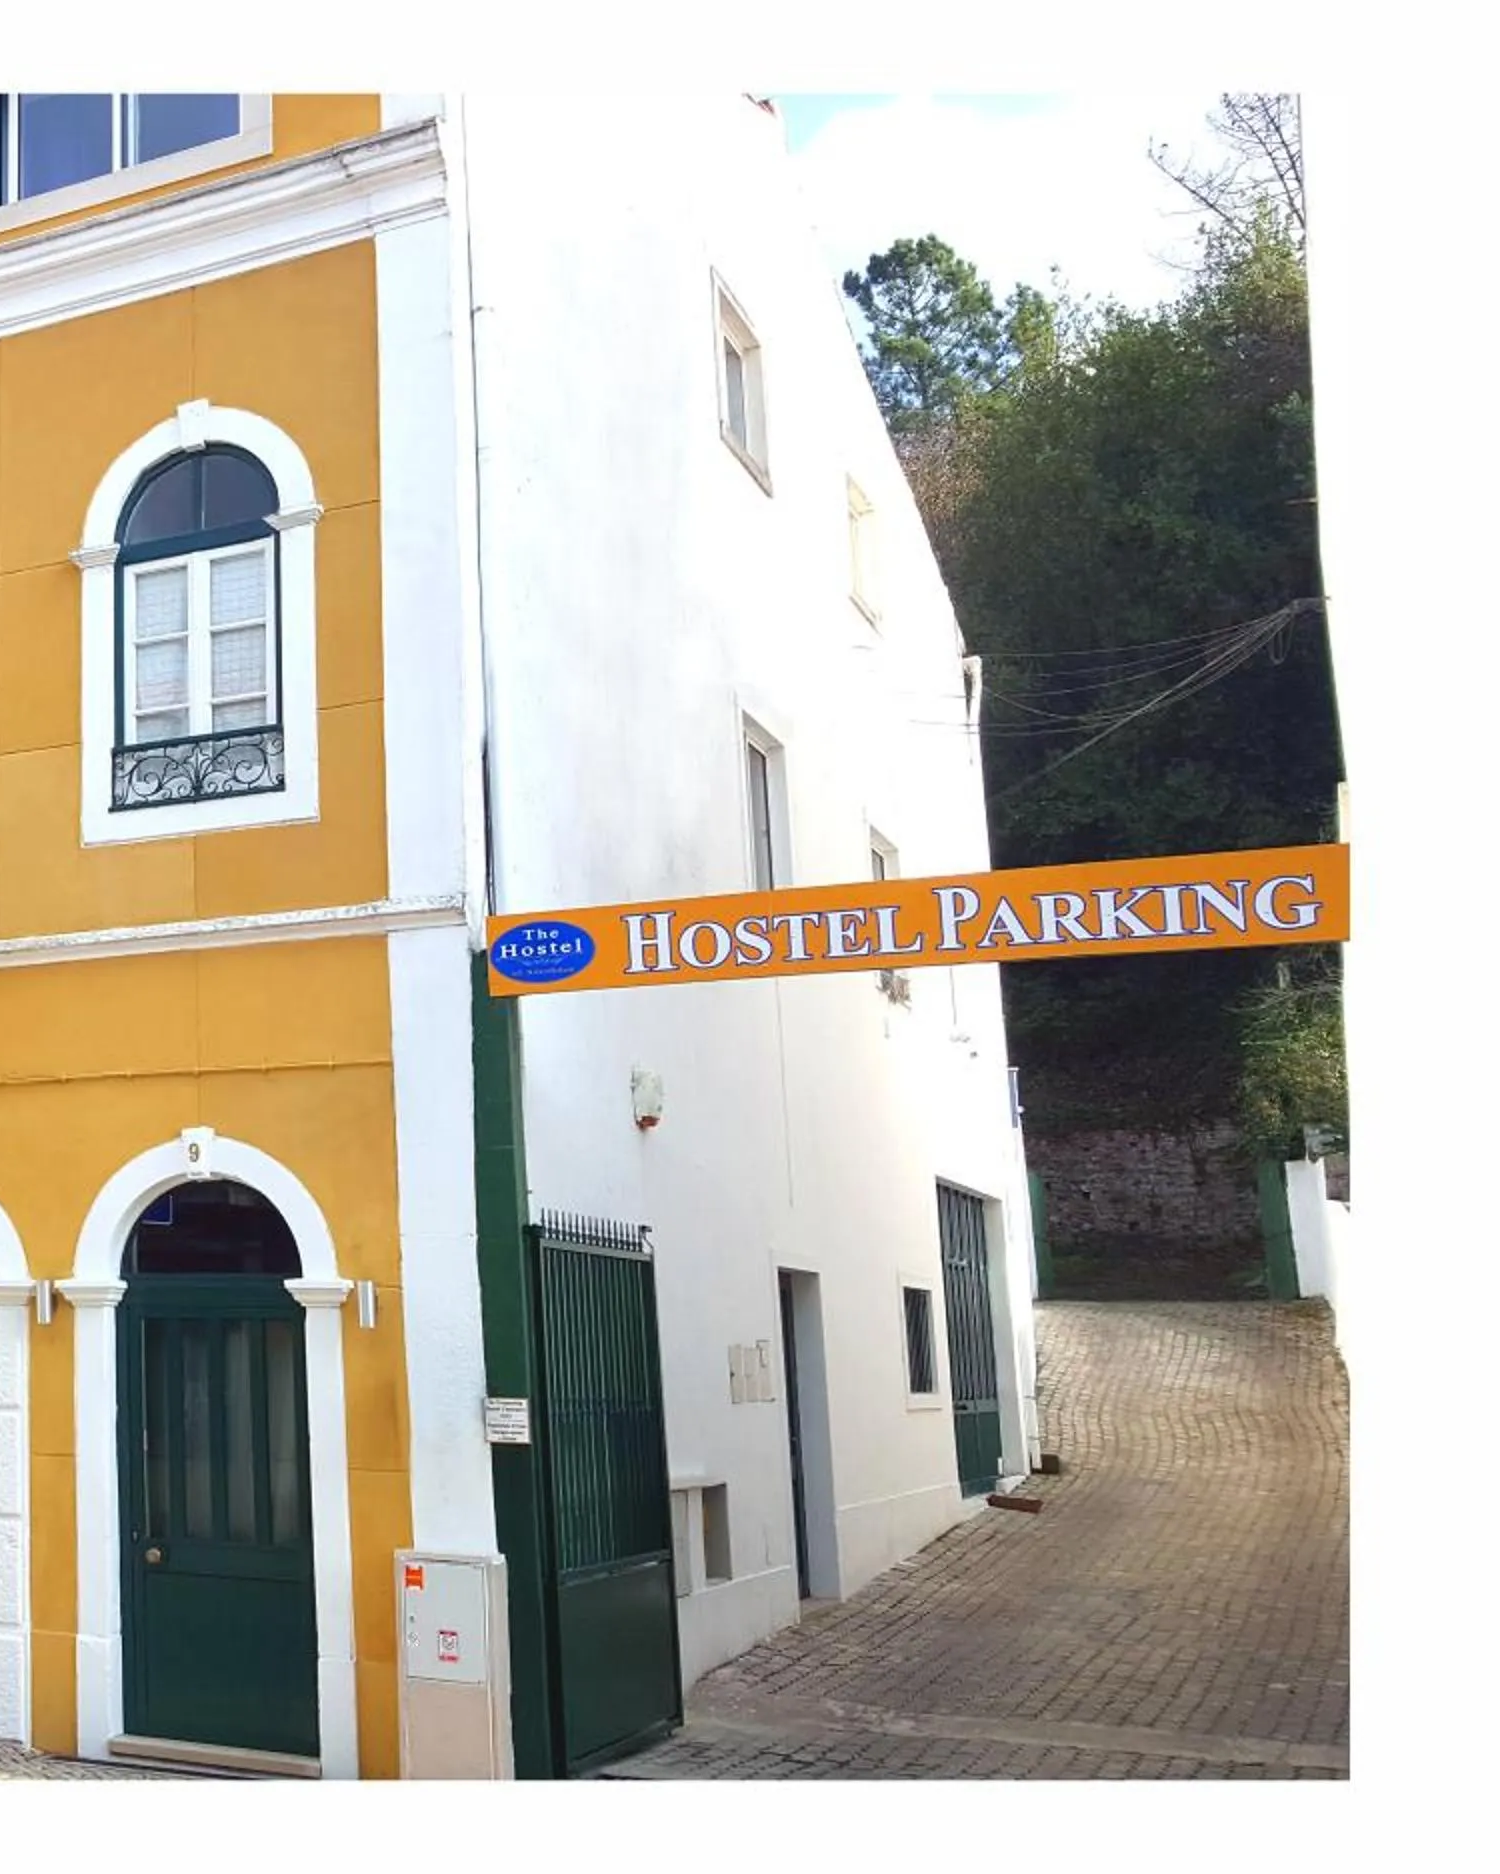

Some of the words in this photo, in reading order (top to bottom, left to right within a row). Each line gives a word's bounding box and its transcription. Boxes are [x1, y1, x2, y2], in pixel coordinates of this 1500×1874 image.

[522, 927, 560, 941] The
[620, 906, 925, 975] HOSTEL
[931, 873, 1323, 952] PARKING
[500, 937, 582, 959] Hostel
[188, 1142, 200, 1163] 9
